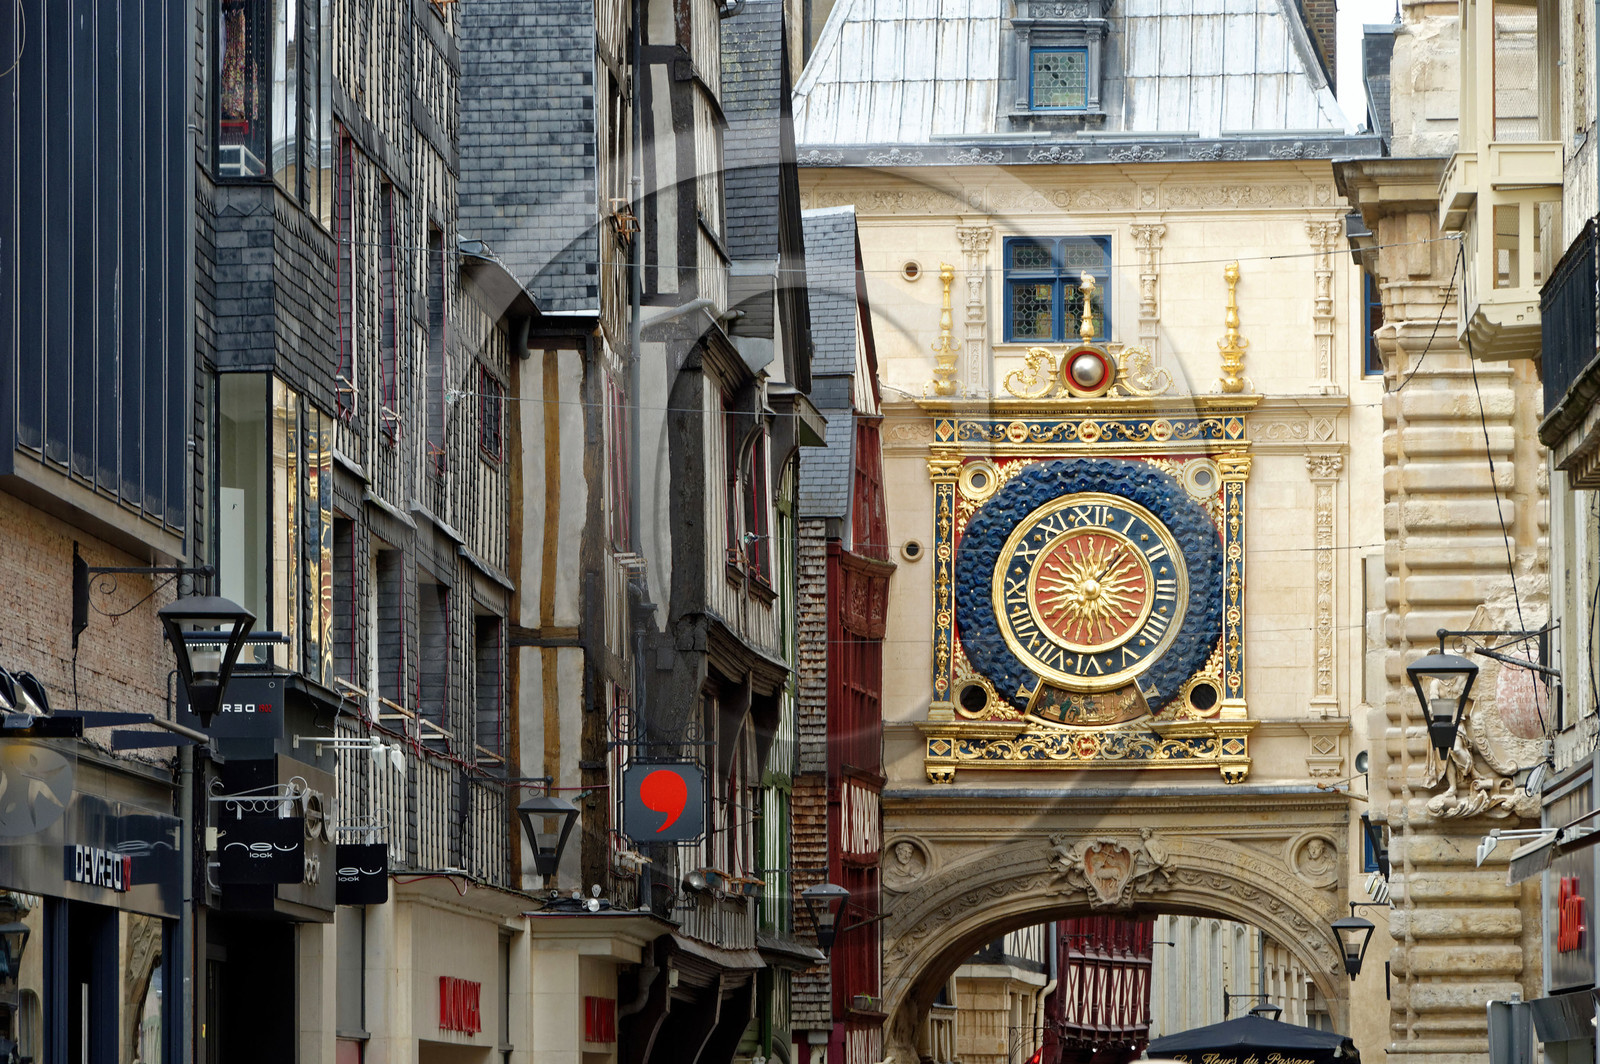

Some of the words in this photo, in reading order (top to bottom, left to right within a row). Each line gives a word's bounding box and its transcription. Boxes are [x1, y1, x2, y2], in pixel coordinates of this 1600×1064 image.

[1073, 506, 1109, 527] XII
[1121, 515, 1137, 535] I
[1037, 514, 1069, 542] XI
[1013, 540, 1040, 566] X
[1145, 542, 1168, 563] II
[1006, 577, 1027, 604] IX
[1157, 579, 1177, 602] III
[1010, 608, 1035, 650] VIII
[1139, 612, 1170, 645] IIII
[1034, 643, 1065, 672] VII
[1075, 654, 1105, 676] VI
[1121, 646, 1140, 668] V
[224, 842, 299, 853] new
[336, 867, 382, 876] ew
[1244, 1053, 1259, 1064] du
